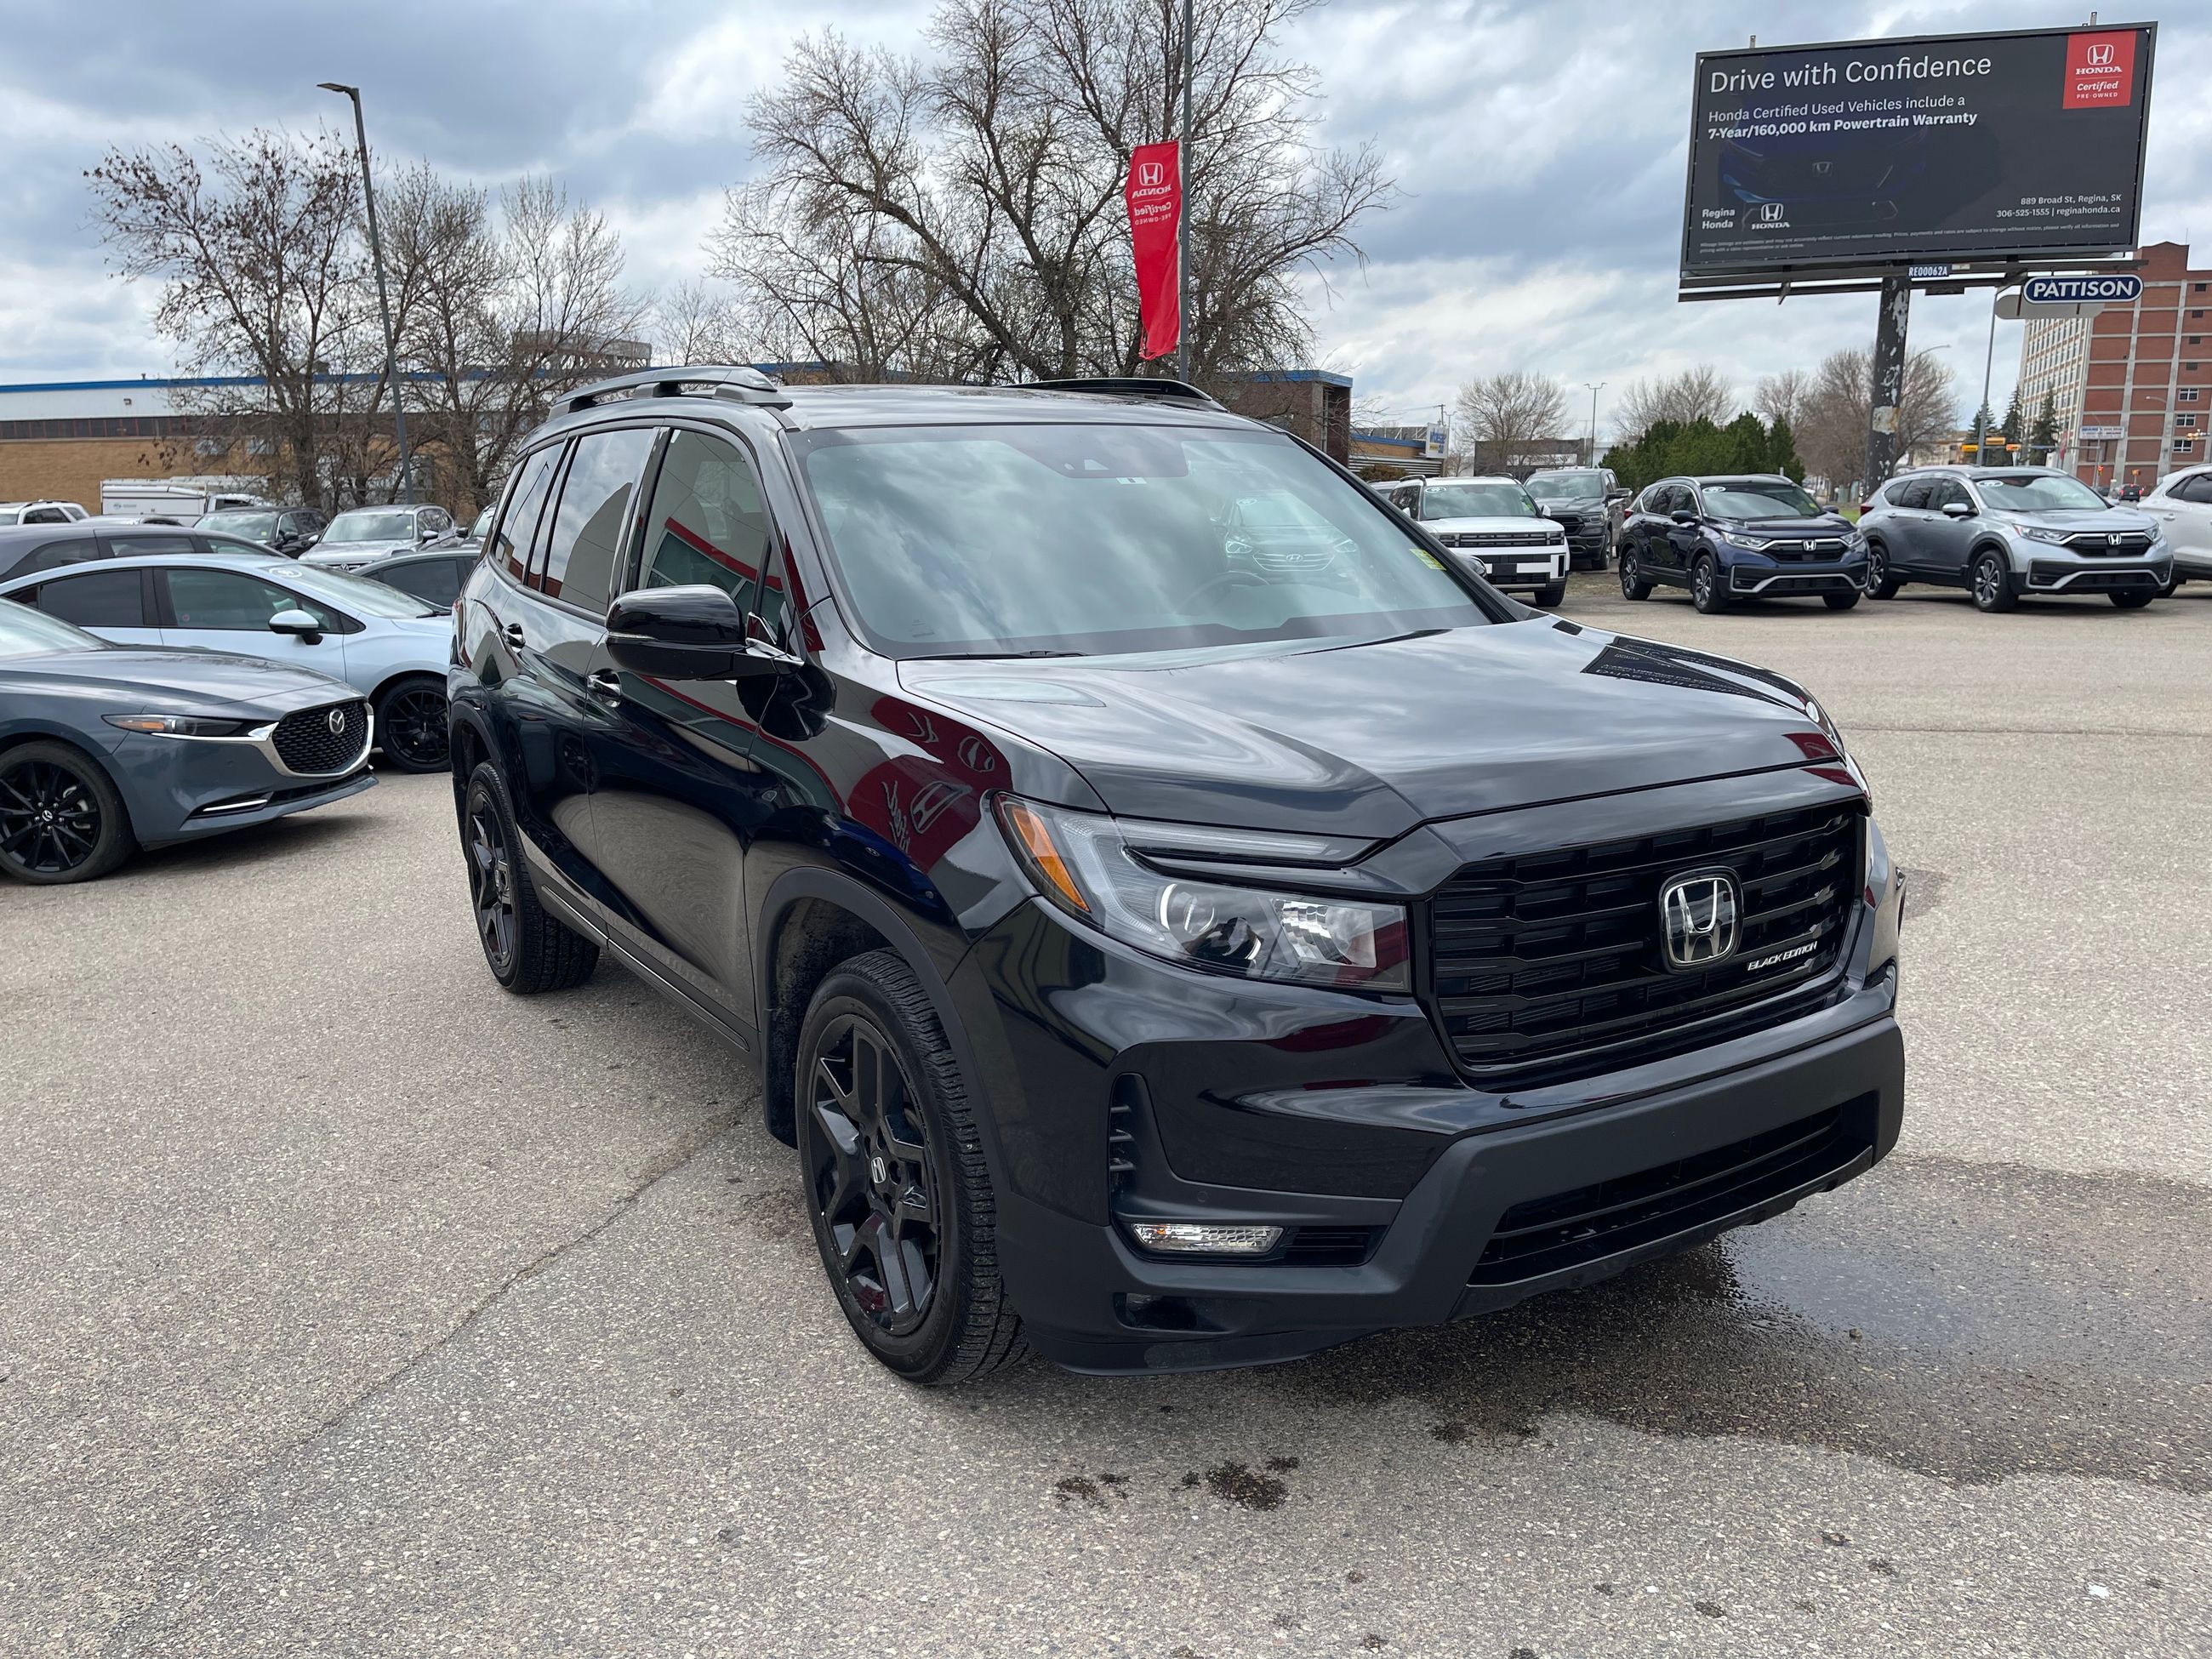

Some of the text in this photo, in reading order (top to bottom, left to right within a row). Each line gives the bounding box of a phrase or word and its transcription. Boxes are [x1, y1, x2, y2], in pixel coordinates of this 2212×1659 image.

[1710, 55, 1992, 93] Drive with Confidence
[2075, 66, 2123, 75] HONDA
[2077, 81, 2119, 92] Certified
[1708, 95, 1965, 123] Honda Certified Used Vehicles include a
[1707, 111, 1978, 140] 7-Year/160,000 km Powertrain Warranty
[2038, 196, 2062, 204] Broad
[2064, 196, 2076, 204] St,
[2078, 194, 2109, 204] Regina,
[1702, 208, 1736, 219] Regina
[1997, 208, 2050, 218] 306-525-1555
[2056, 206, 2120, 216] reginahonda.ca
[1702, 219, 1734, 230] Honda
[1751, 221, 1790, 230] HONDA
[1908, 265, 1947, 277] RE00062A
[2032, 279, 2134, 299] PATTISON
[1747, 940, 1818, 972] BLACK EDITION
